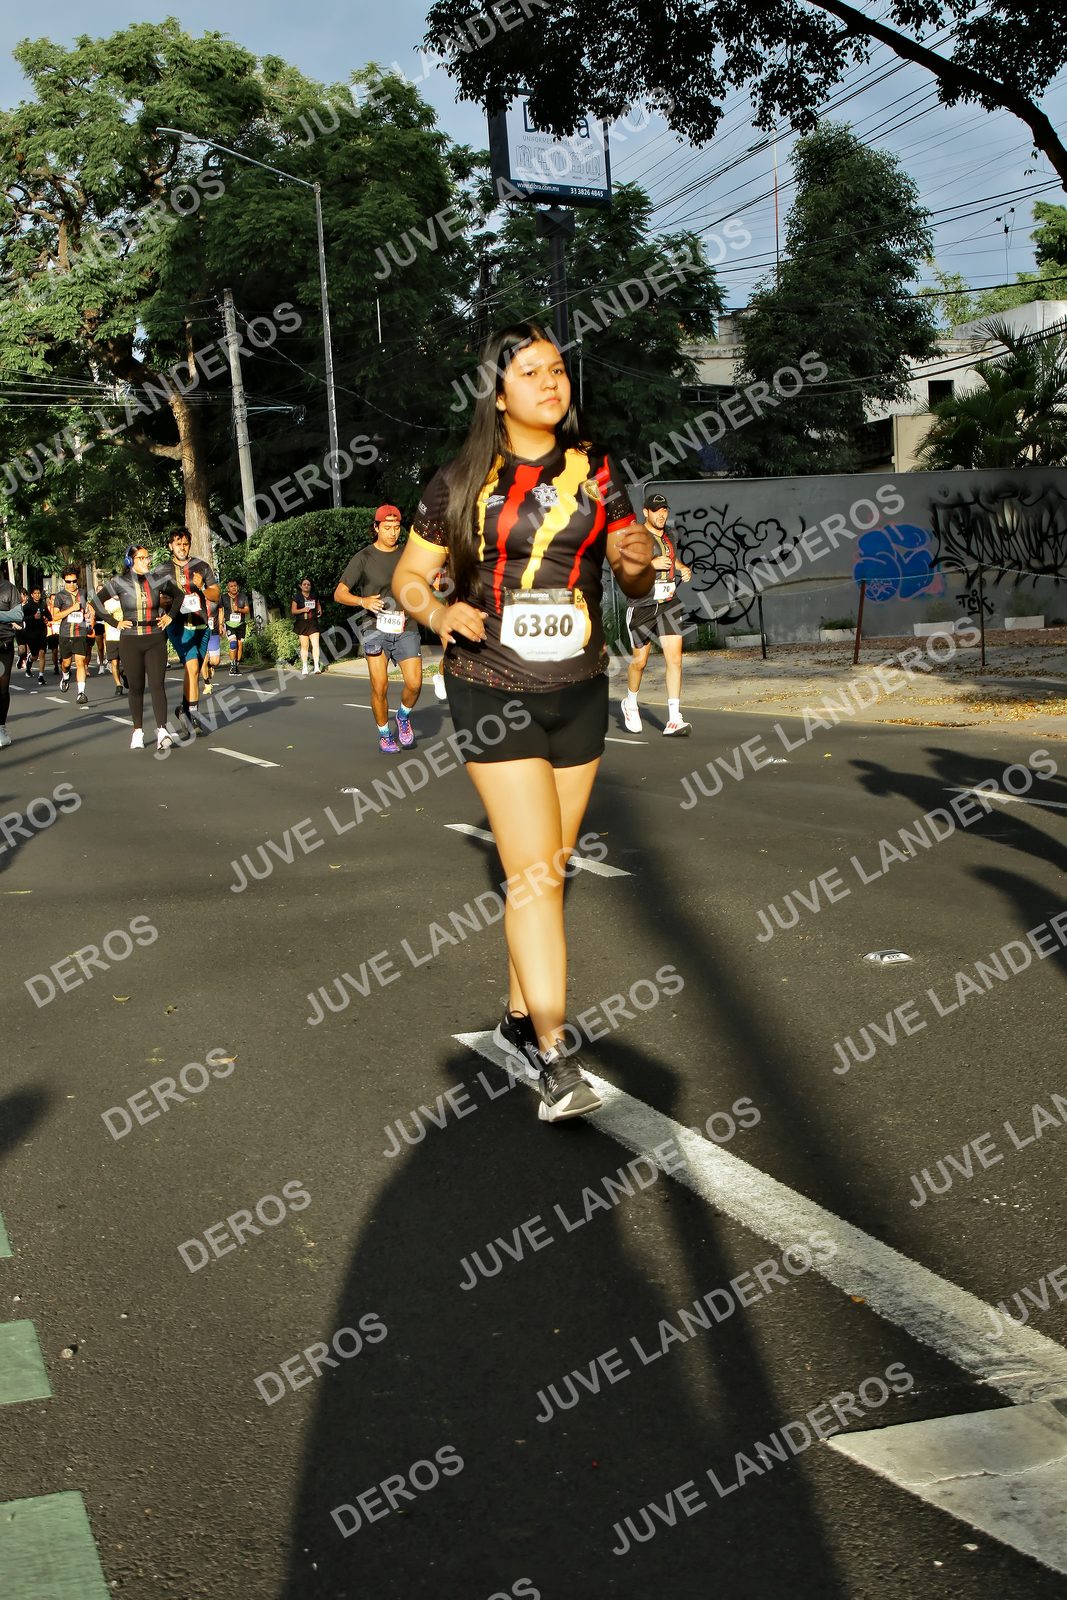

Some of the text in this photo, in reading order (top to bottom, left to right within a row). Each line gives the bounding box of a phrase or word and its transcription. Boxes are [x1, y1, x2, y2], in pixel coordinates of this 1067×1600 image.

[570, 187, 578, 195] 33
[676, 503, 728, 525] TOY
[514, 613, 573, 637] 6380
